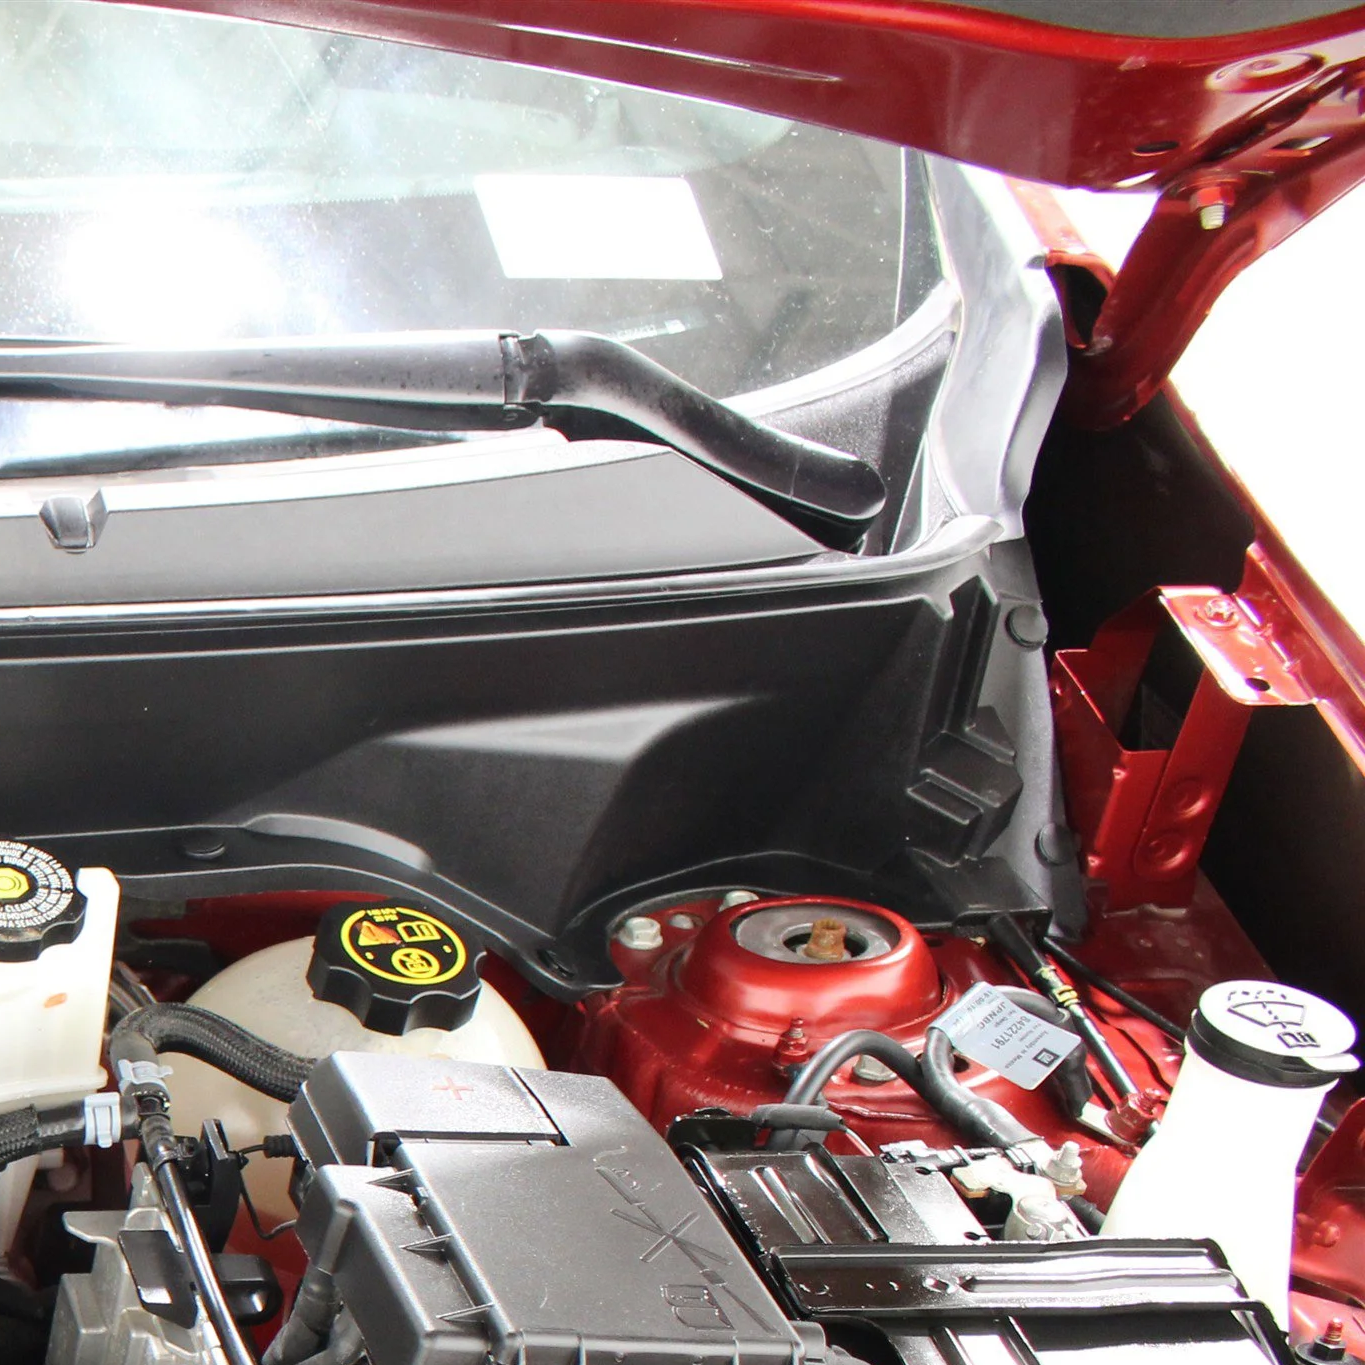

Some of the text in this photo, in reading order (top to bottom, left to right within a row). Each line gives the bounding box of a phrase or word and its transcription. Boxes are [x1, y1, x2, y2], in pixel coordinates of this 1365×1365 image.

[989, 1015, 1032, 1050] 84221791
[1023, 1029, 1050, 1050] Assembly
[1003, 1053, 1024, 1070] Mexico
